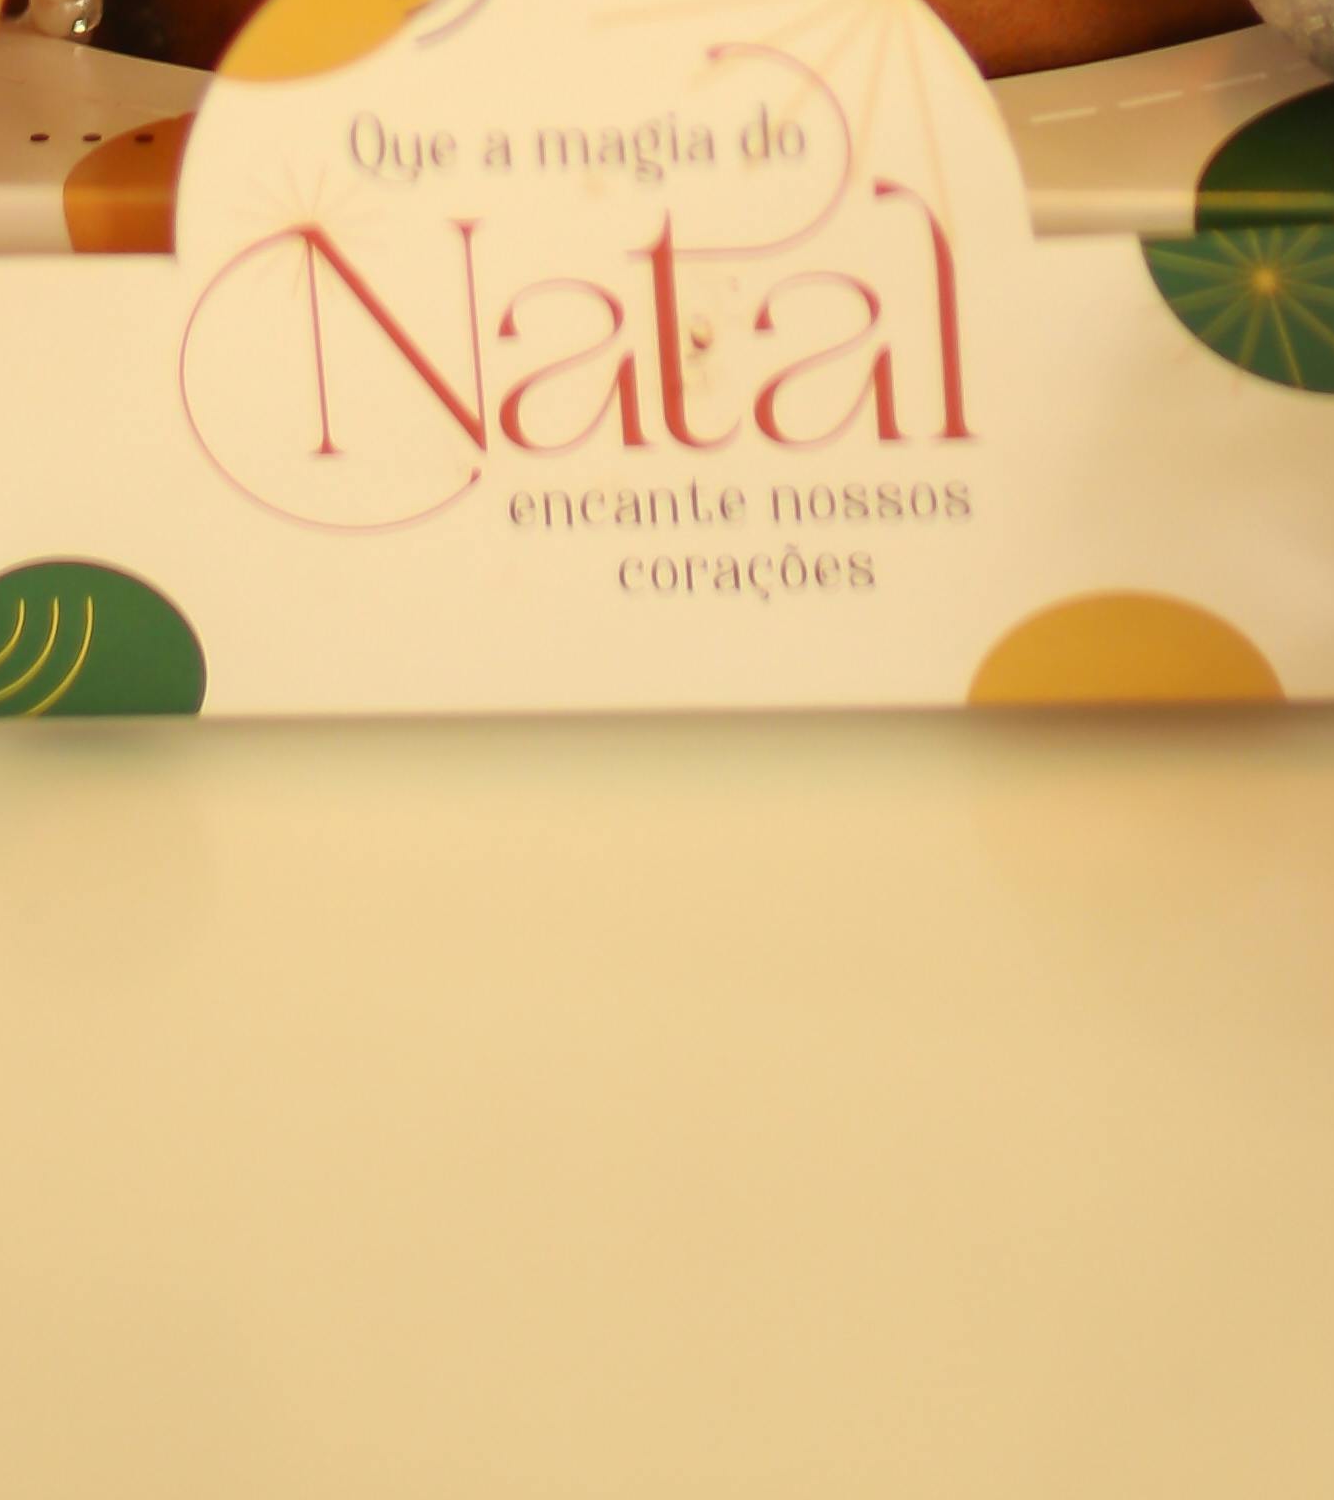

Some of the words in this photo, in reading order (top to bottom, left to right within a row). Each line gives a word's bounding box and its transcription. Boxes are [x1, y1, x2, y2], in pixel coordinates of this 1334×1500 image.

[348, 107, 459, 184] Que
[482, 132, 513, 169] a
[534, 111, 716, 182] magia
[739, 101, 808, 164] do
[180, 44, 981, 530] Natal
[508, 477, 748, 528] encante
[769, 477, 973, 524] nossos
[616, 542, 877, 601] corações
